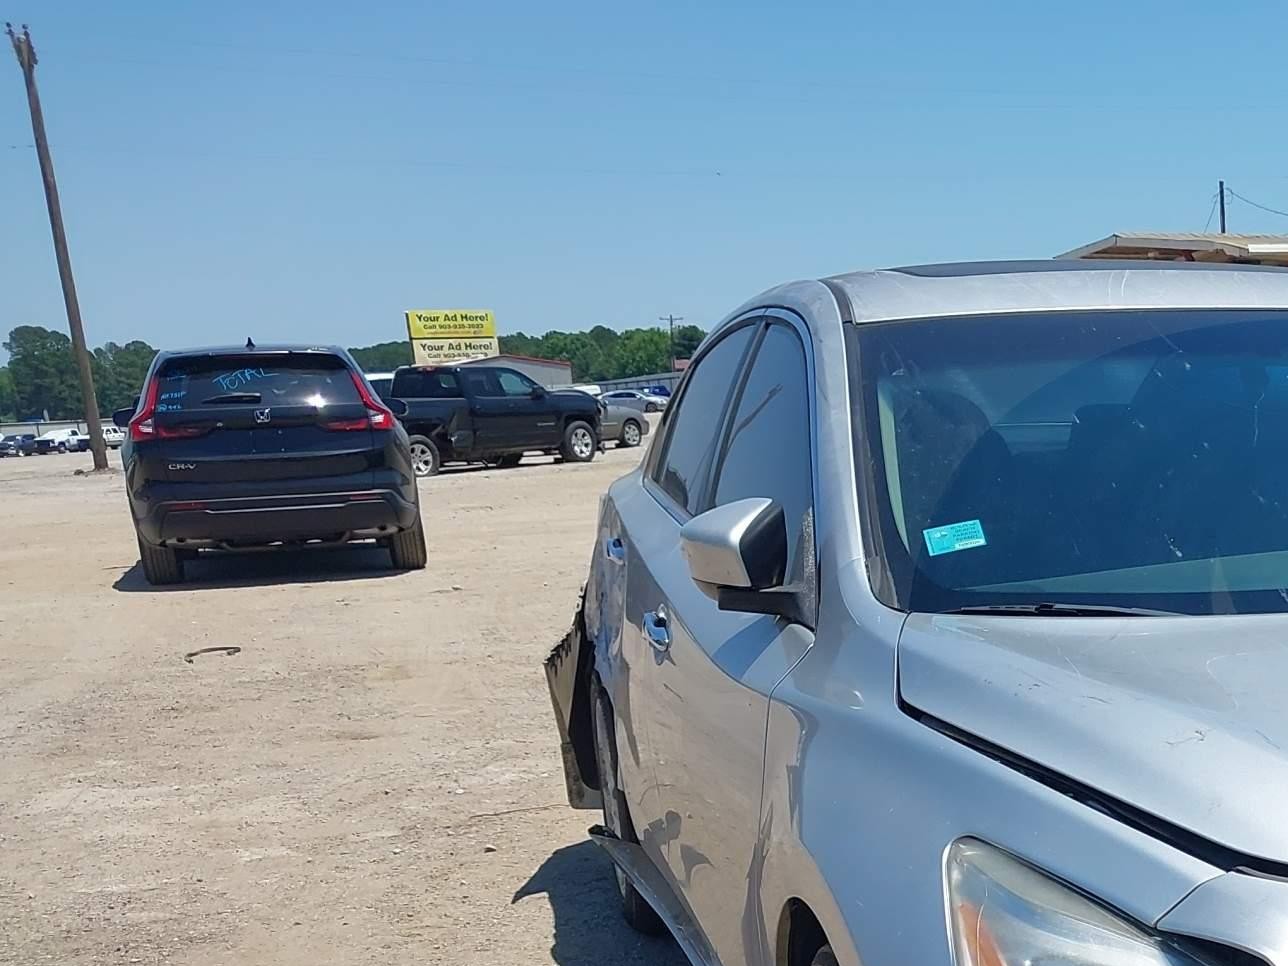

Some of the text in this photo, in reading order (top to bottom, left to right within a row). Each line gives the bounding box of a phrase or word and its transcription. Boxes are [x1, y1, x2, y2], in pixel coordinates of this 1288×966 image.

[416, 313, 489, 322] Your Ad Here!
[420, 342, 493, 351] Your Ad Here!
[212, 367, 281, 391] TOTAL
